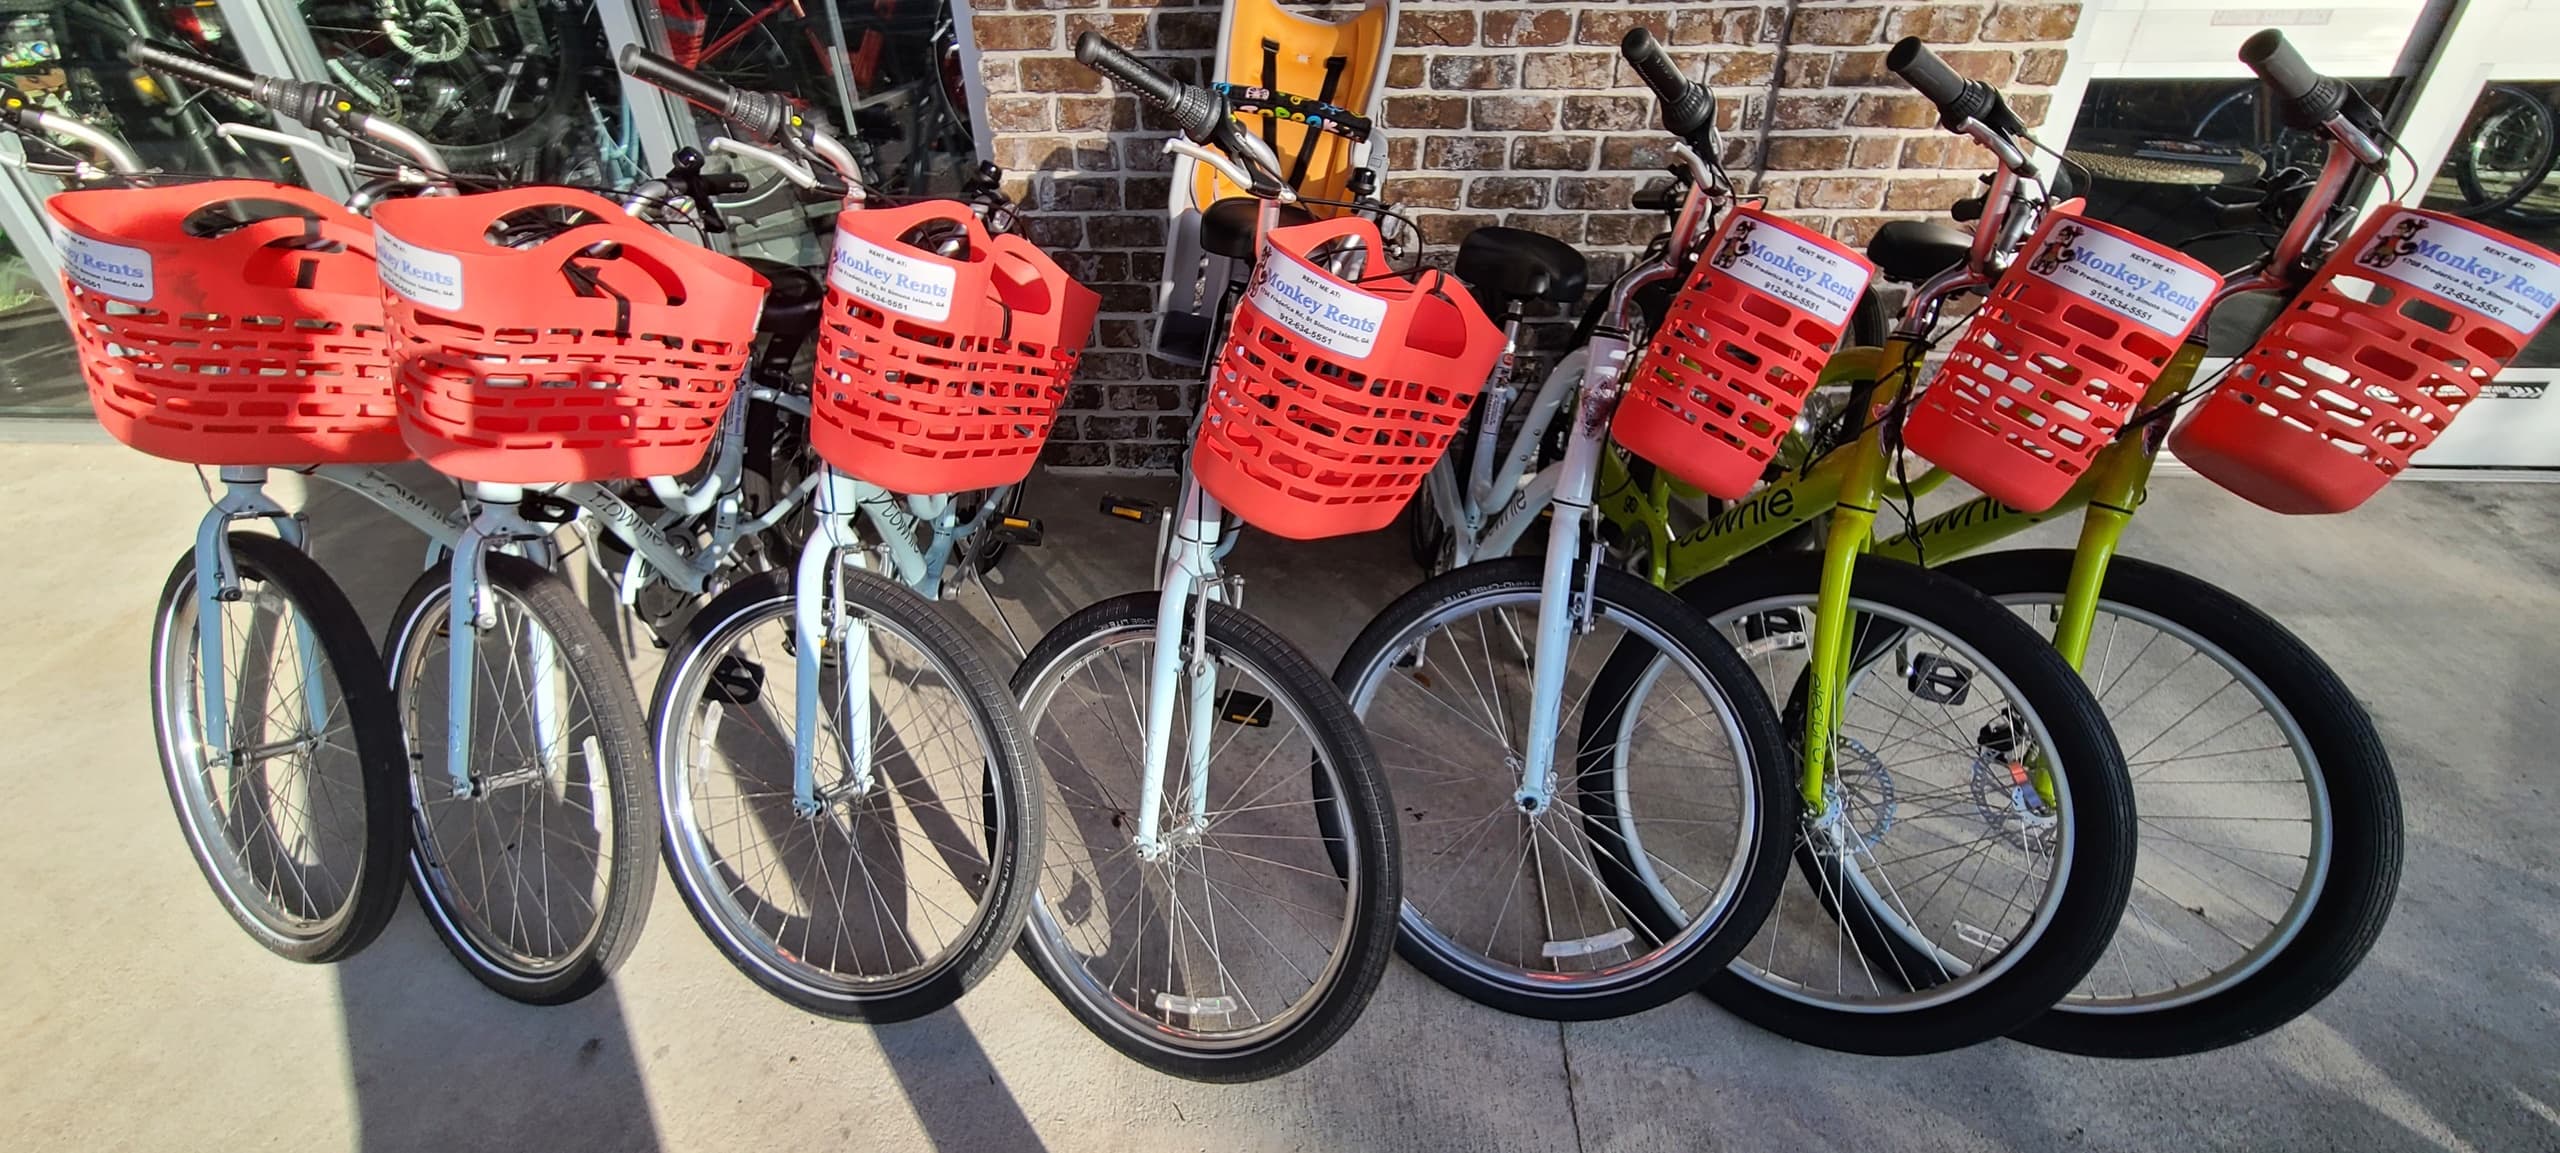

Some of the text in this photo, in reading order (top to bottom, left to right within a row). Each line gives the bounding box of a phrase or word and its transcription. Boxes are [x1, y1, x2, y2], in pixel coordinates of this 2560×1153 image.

[83, 252, 145, 279] Rents
[1797, 245, 1816, 257] RENT
[1816, 252, 1827, 262] ME
[2130, 252, 2152, 265] RENT
[2152, 262, 2164, 271] ME
[2483, 246, 2508, 259] RENT
[2507, 254, 2522, 264] ME
[402, 259, 454, 286] Rents
[836, 247, 948, 298] Monkey Rents
[1302, 274, 1318, 287] RENT
[1318, 282, 1329, 293] ME
[1749, 239, 1857, 302] Monkey Rents
[2074, 245, 2200, 312] Monkey Rents
[2415, 239, 2558, 310] Monkey Rents
[1267, 267, 1377, 333] Monkey Rents
[1764, 281, 1820, 312] 912-634-5551
[2089, 289, 2153, 321] 912-634-5551
[2432, 281, 2505, 317] 912-634-5551
[1279, 312, 1333, 345] 912-634-5551
